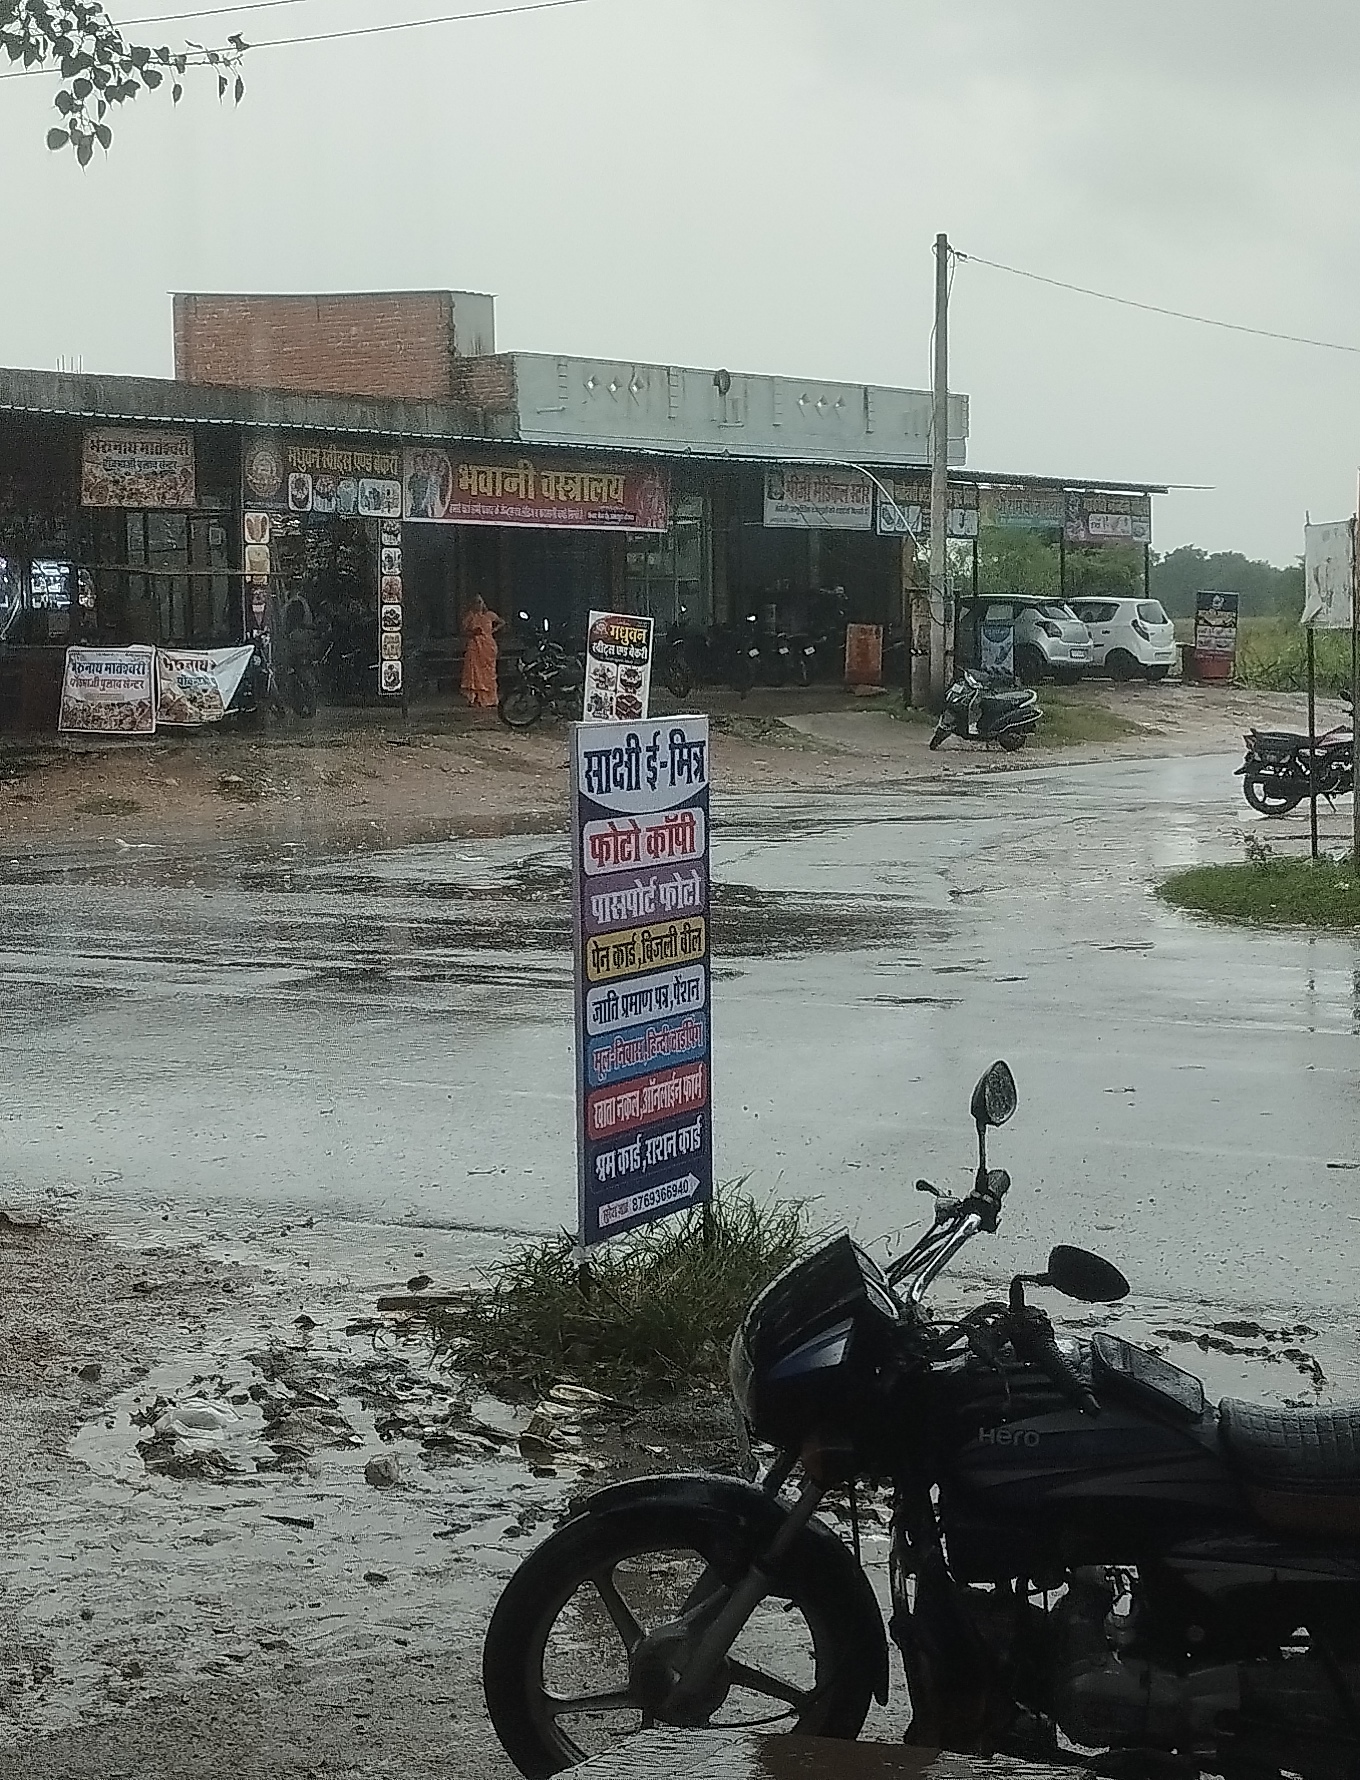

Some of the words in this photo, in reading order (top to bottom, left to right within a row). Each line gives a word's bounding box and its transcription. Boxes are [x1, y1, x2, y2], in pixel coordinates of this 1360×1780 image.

[458, 459, 537, 500] भवानी
[540, 470, 626, 504] वस्त्रालय
[583, 732, 642, 795] साक्षी
[646, 728, 707, 792] ई-मित्र
[589, 818, 642, 869] फोटो
[645, 811, 697, 860] कॉपी
[590, 875, 657, 925] पासपोर्ट
[659, 868, 702, 912] फोटो
[591, 940, 611, 975] पेन
[591, 988, 620, 1025] जाति
[620, 988, 653, 1019] प्रमाण
[593, 1096, 616, 1130] खाता
[682, 1063, 704, 1103] फार्म
[595, 1149, 617, 1183] श्रम
[645, 1129, 678, 1167] राशन
[678, 1114, 703, 1156] कार्ड
[978, 1427, 1040, 1448] Hero
